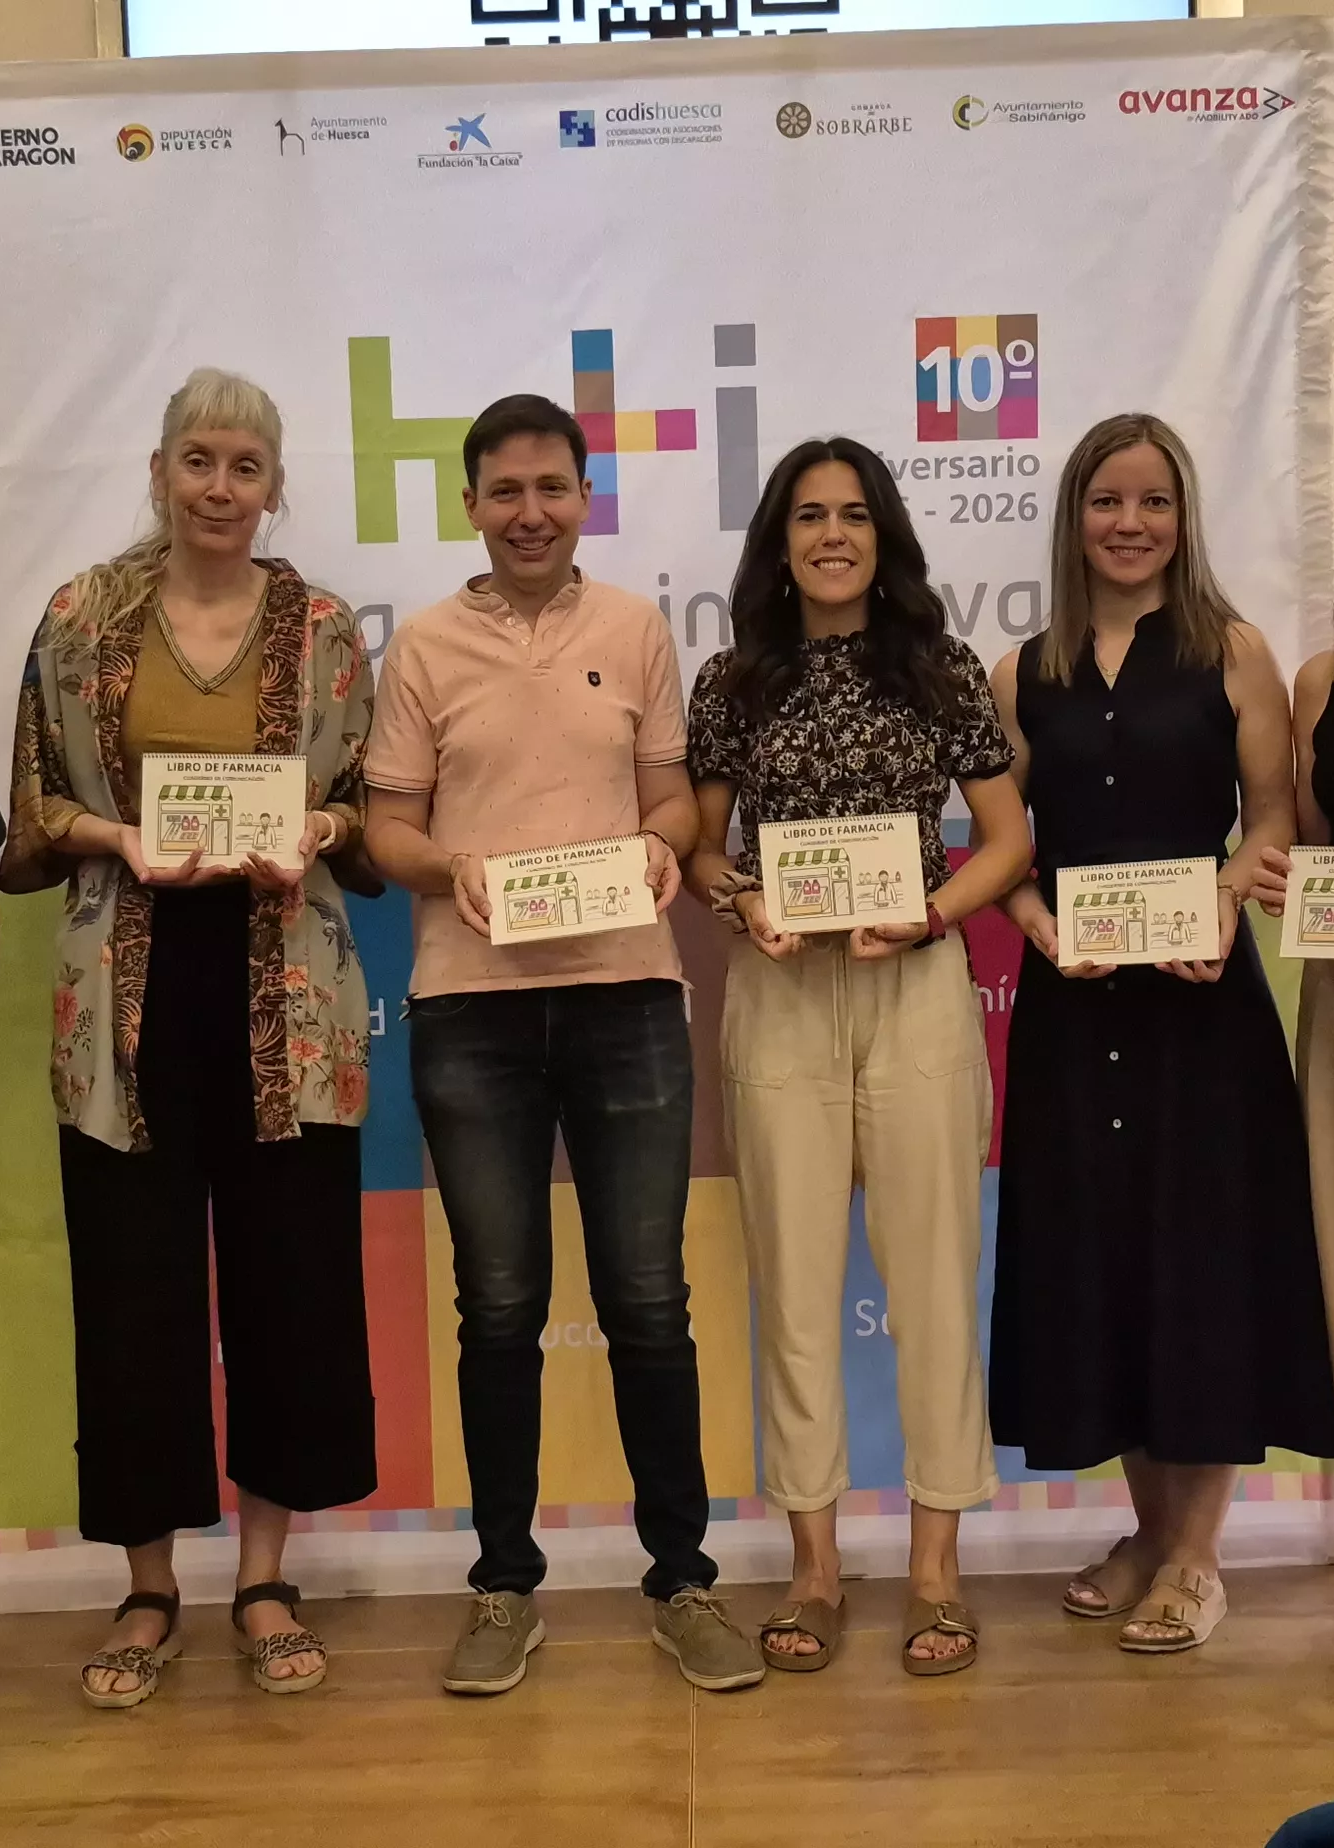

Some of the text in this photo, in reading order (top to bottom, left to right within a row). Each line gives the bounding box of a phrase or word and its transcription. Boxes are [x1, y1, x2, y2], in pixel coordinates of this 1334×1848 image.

[993, 100, 1084, 113] Ayuntamiento
[1118, 86, 1259, 115] avanza
[605, 101, 722, 122] cadishuesca
[1008, 111, 1086, 123] Sabiñánigo
[1195, 113, 1238, 122] MOBILITY
[1239, 112, 1259, 120] ADO
[310, 116, 387, 130] Ayuntamiento
[816, 116, 913, 136] SOBRARBE
[160, 126, 232, 141] DIPUTACIÓN
[311, 129, 370, 141] de Huesca
[161, 139, 232, 151] HUESCA
[417, 156, 474, 168] Fundación
[949, 491, 1039, 524] 2026
[167, 762, 282, 773] LIBRO DE FARMACIA
[783, 822, 895, 839] LIBRO DE FARMACIA
[508, 856, 543, 869] LIBRO
[546, 854, 560, 863] DE
[563, 845, 622, 861] FARMACIA
[1080, 866, 1193, 882] LIBRO DE FARMACIA
